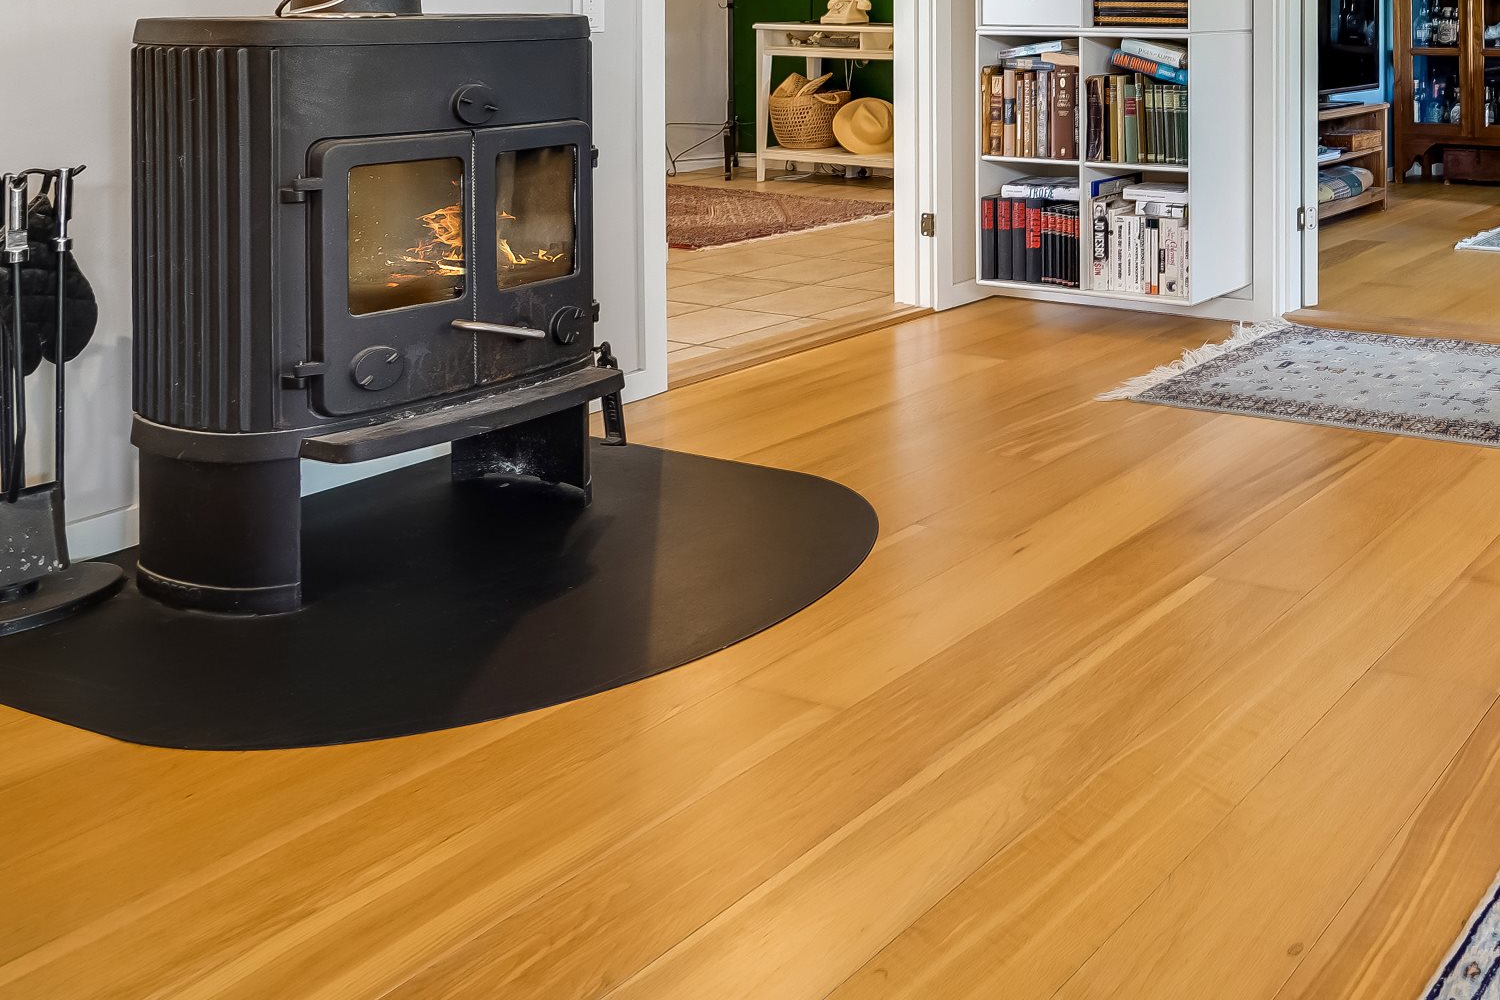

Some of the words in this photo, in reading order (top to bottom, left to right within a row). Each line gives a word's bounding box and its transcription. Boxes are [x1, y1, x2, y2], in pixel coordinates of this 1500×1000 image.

[1114, 54, 1130, 68] DAN
[1130, 56, 1158, 75] BROWN
[1094, 220, 1105, 230] JO
